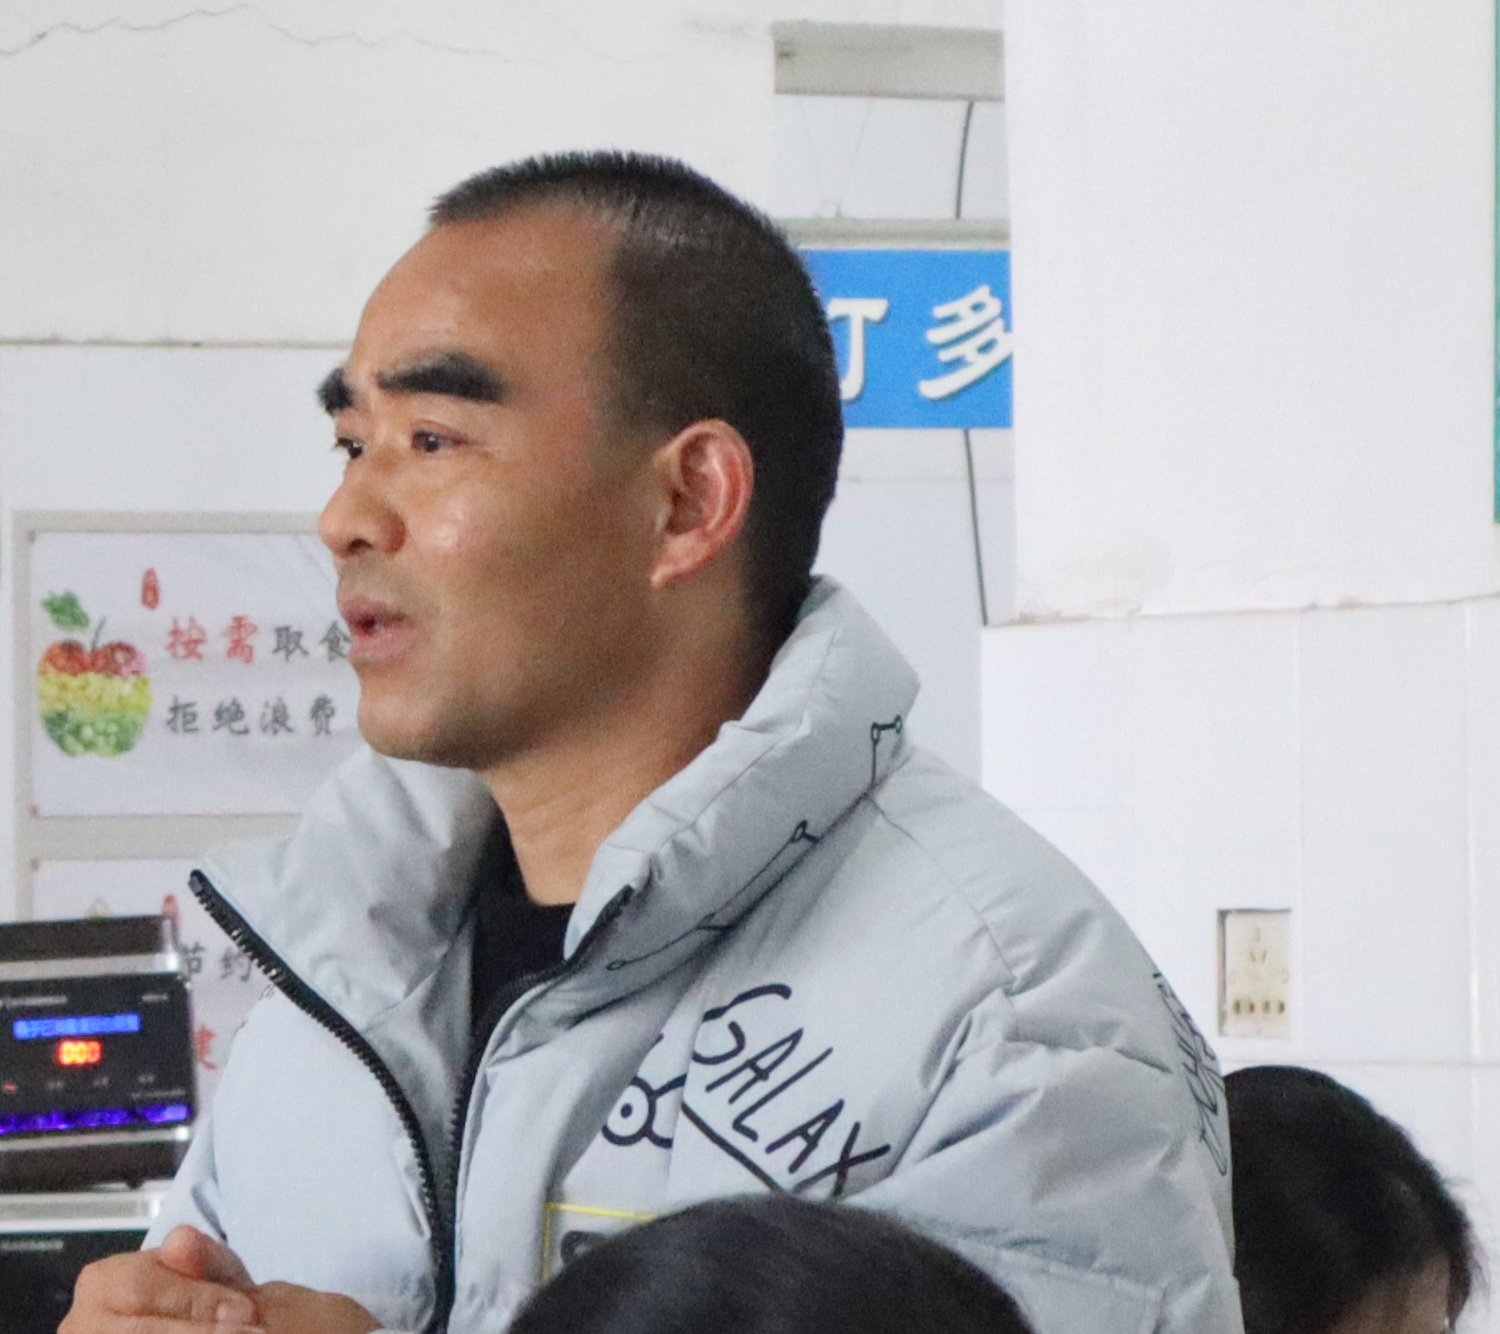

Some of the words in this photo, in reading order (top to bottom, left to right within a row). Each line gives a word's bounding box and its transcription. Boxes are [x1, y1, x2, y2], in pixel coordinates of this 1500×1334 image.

[166, 615, 354, 664] 按需取食
[167, 694, 338, 738] 拒绝浪费
